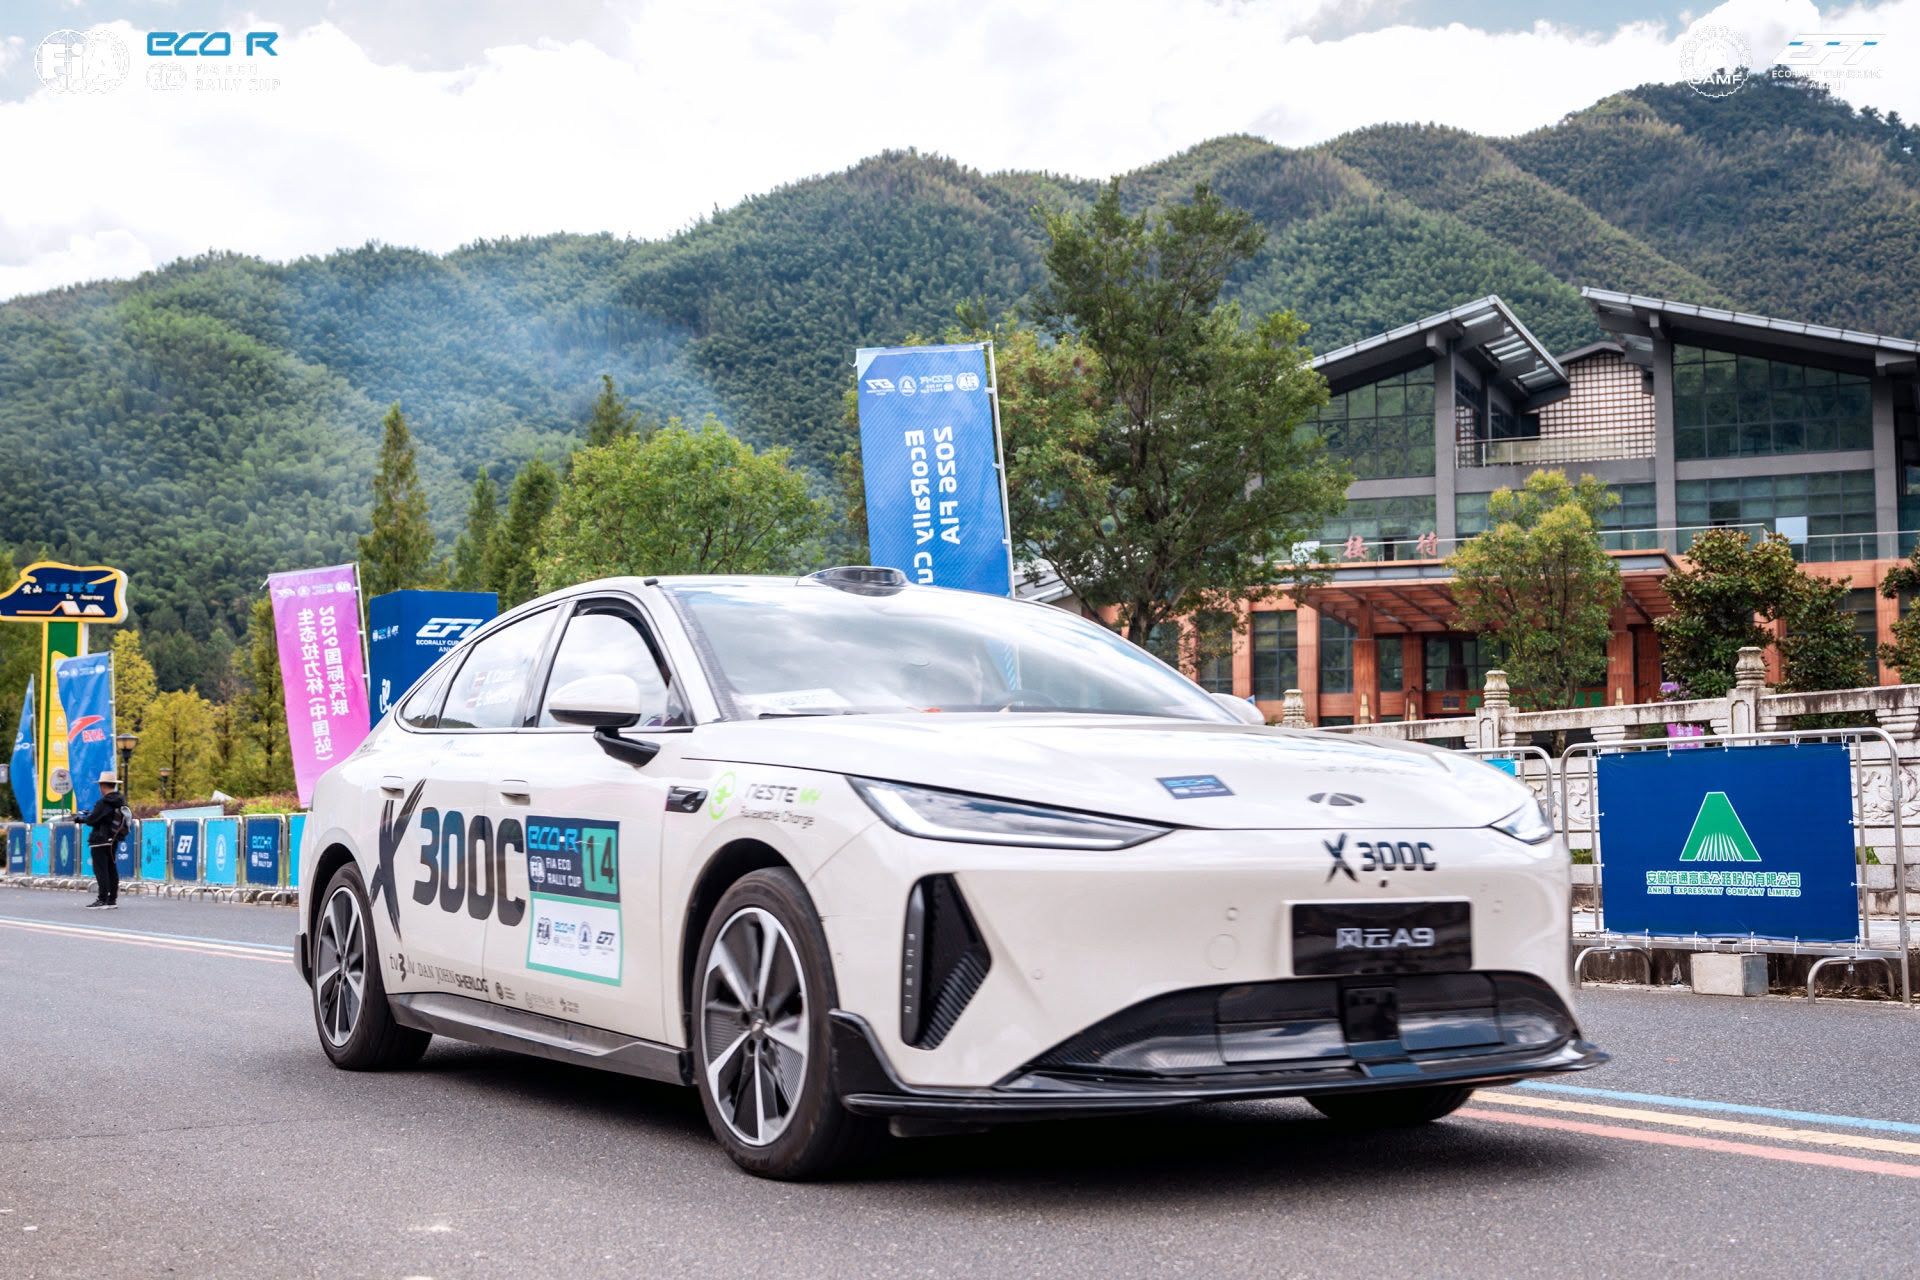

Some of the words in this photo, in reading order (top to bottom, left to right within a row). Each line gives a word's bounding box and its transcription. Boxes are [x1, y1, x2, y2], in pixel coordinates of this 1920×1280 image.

[546, 857, 557, 869] FIA
[586, 835, 614, 884] 14
[547, 872, 567, 885] RALLY
[568, 875, 582, 888] CUP
[1646, 871, 1802, 888] 安徽皖通高速公路股份有限公司
[1647, 886, 1671, 895] ANHUI
[1673, 886, 1724, 896] EXPRESSWAY
[1726, 887, 1766, 897] COMPANY
[1767, 888, 1802, 898] LIMITED
[1336, 927, 1435, 949] 风云A9
